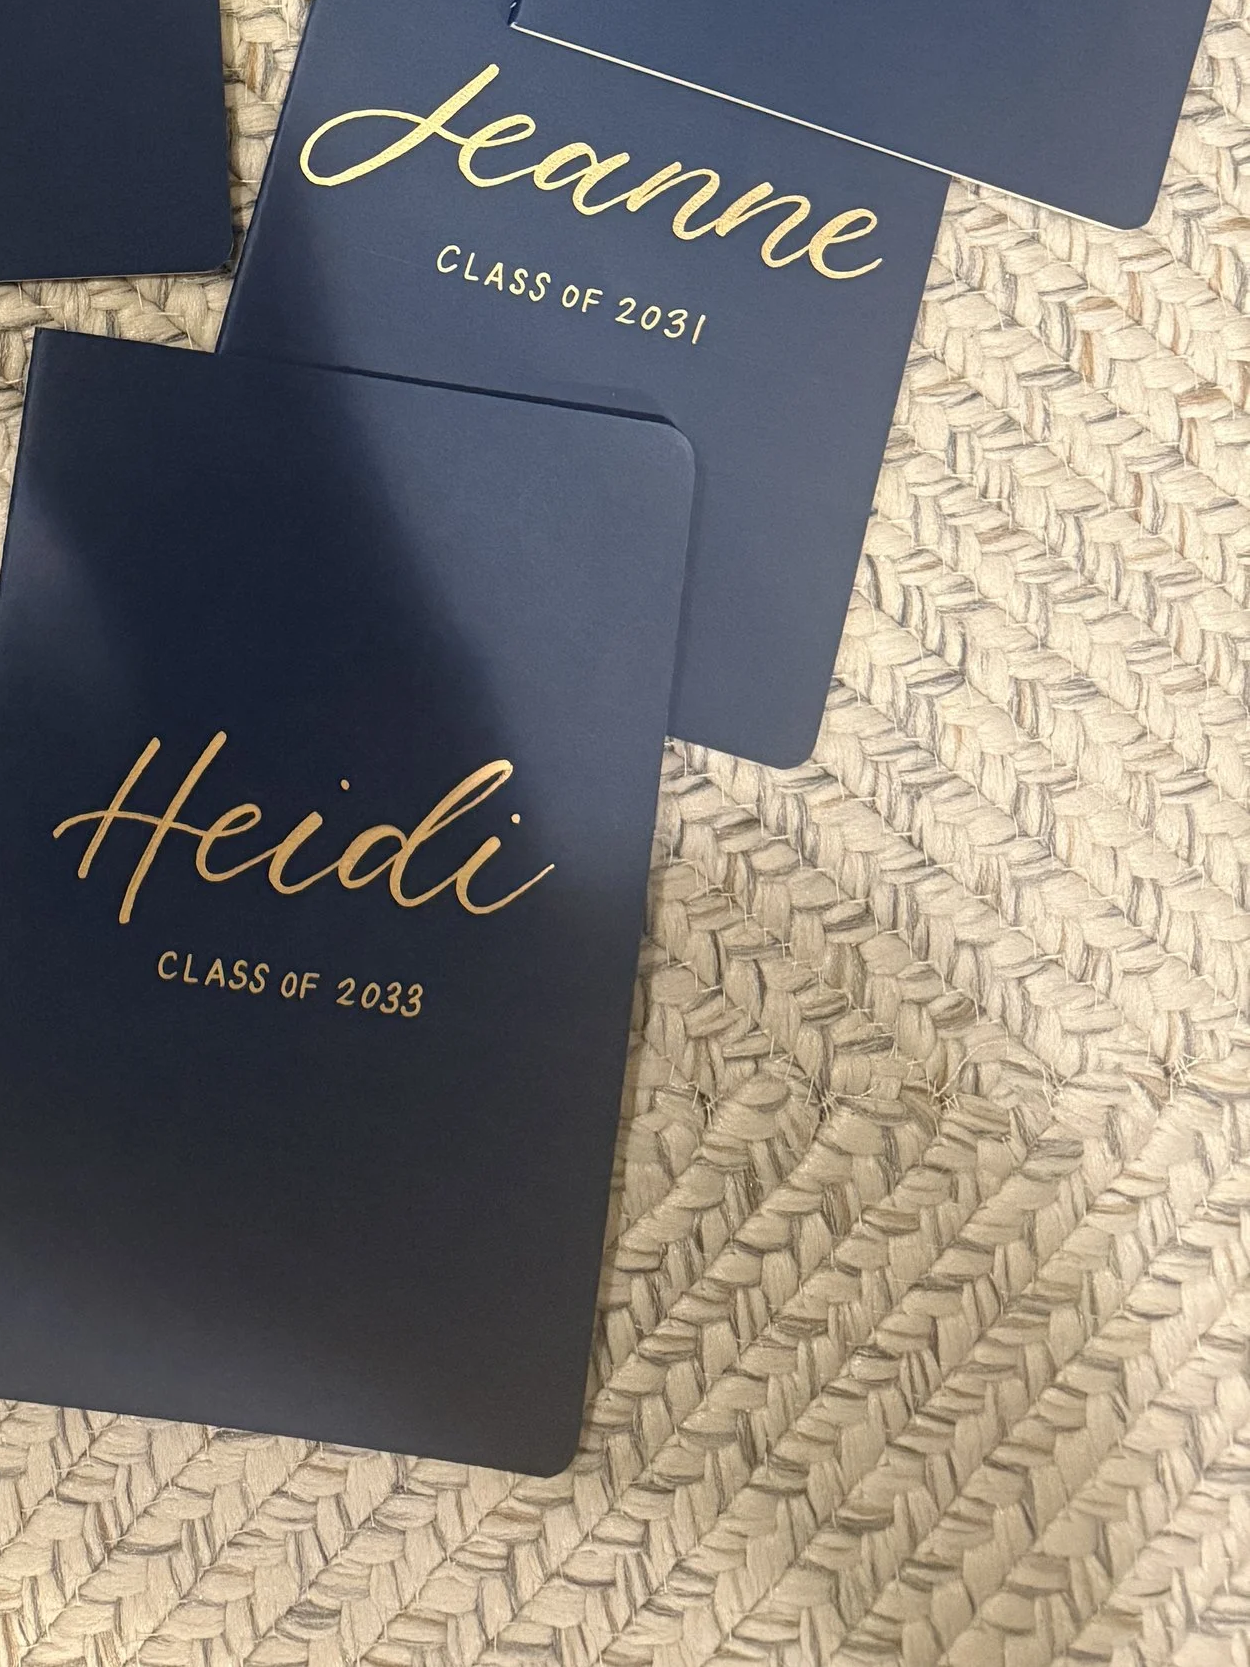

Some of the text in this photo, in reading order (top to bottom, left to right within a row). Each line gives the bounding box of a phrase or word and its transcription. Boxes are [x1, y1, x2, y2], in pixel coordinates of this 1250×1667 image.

[298, 63, 883, 281] Jeanne
[435, 245, 708, 346] CLASS OF 2031
[51, 730, 556, 925] Heidi
[156, 950, 425, 1020] CLASS OF 2033
